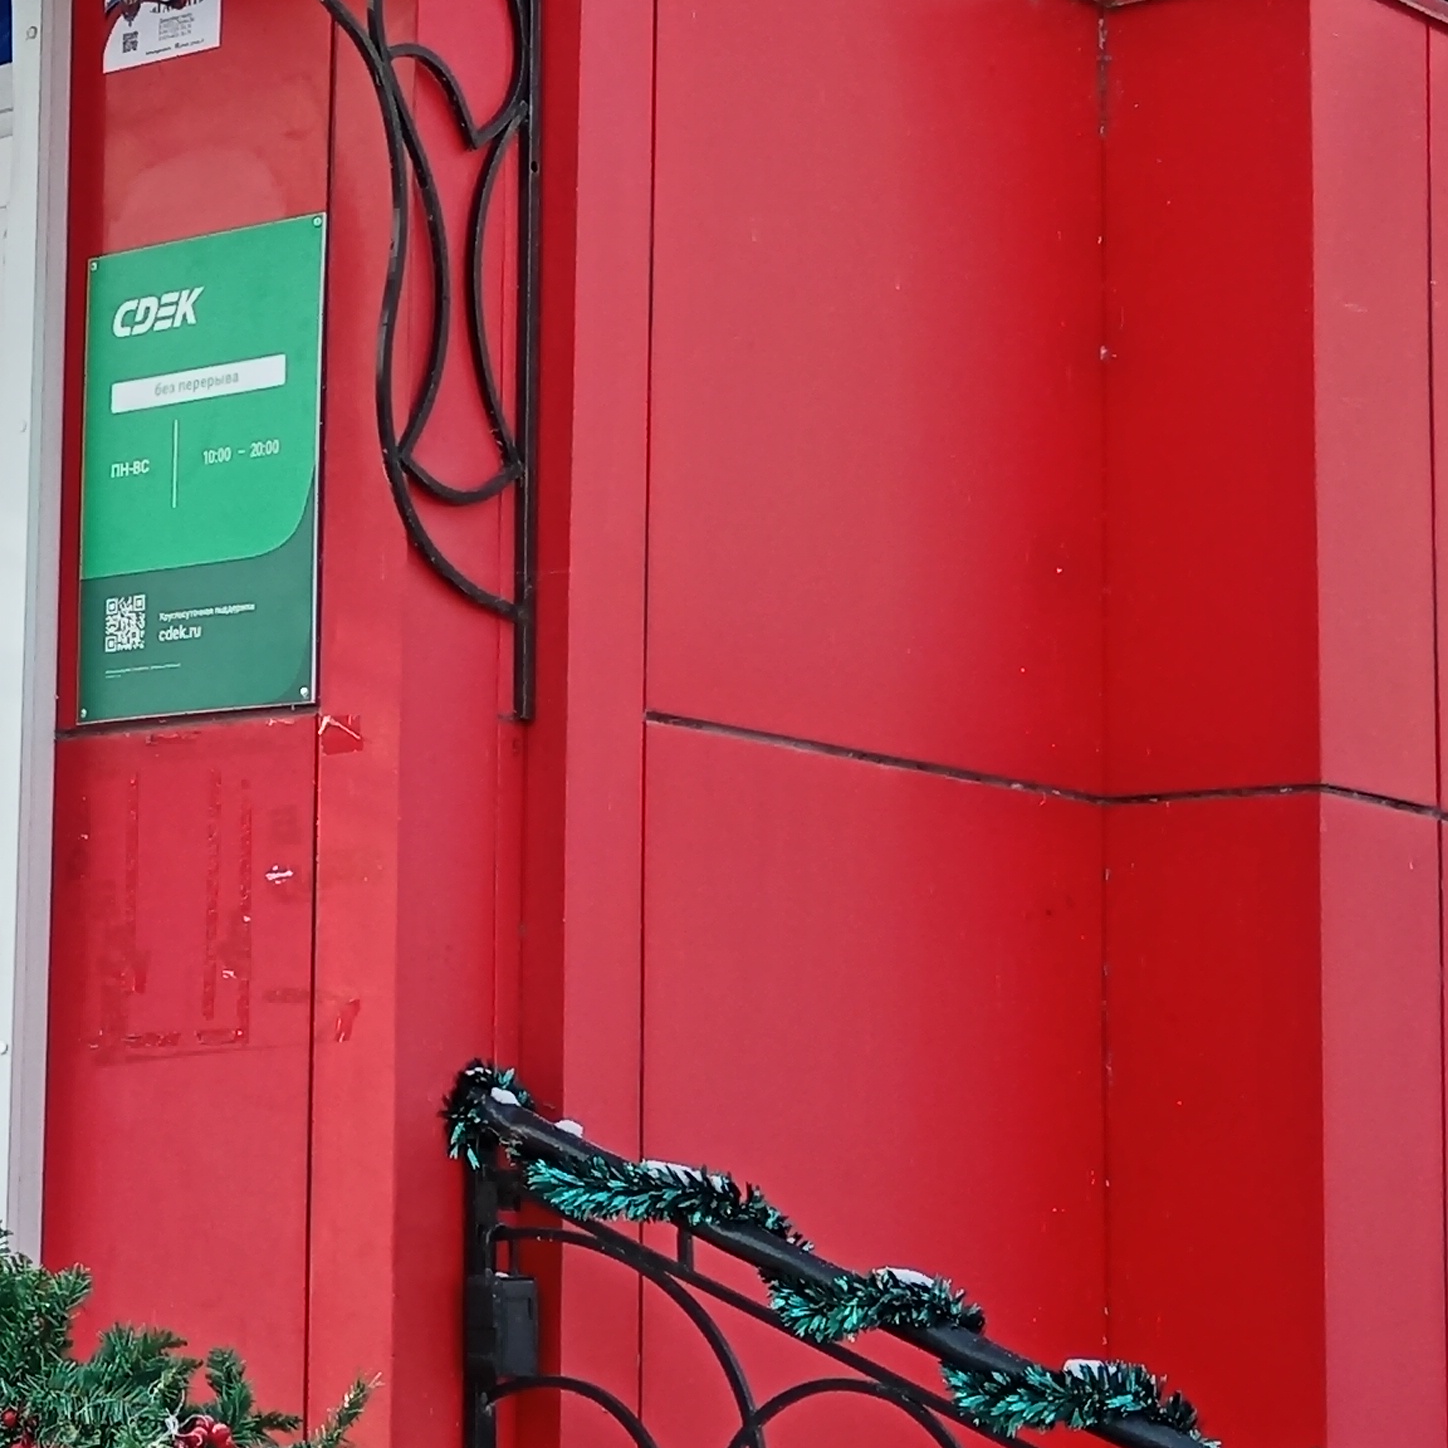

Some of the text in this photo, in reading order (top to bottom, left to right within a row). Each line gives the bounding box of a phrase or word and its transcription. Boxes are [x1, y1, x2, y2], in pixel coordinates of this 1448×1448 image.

[112, 286, 205, 338] CDEK
[154, 372, 240, 397] без перерыва
[203, 447, 232, 465] 10:00
[249, 439, 280, 458] 20:00
[110, 459, 151, 479] ПН-ВС
[158, 624, 203, 642] cdek.ru
